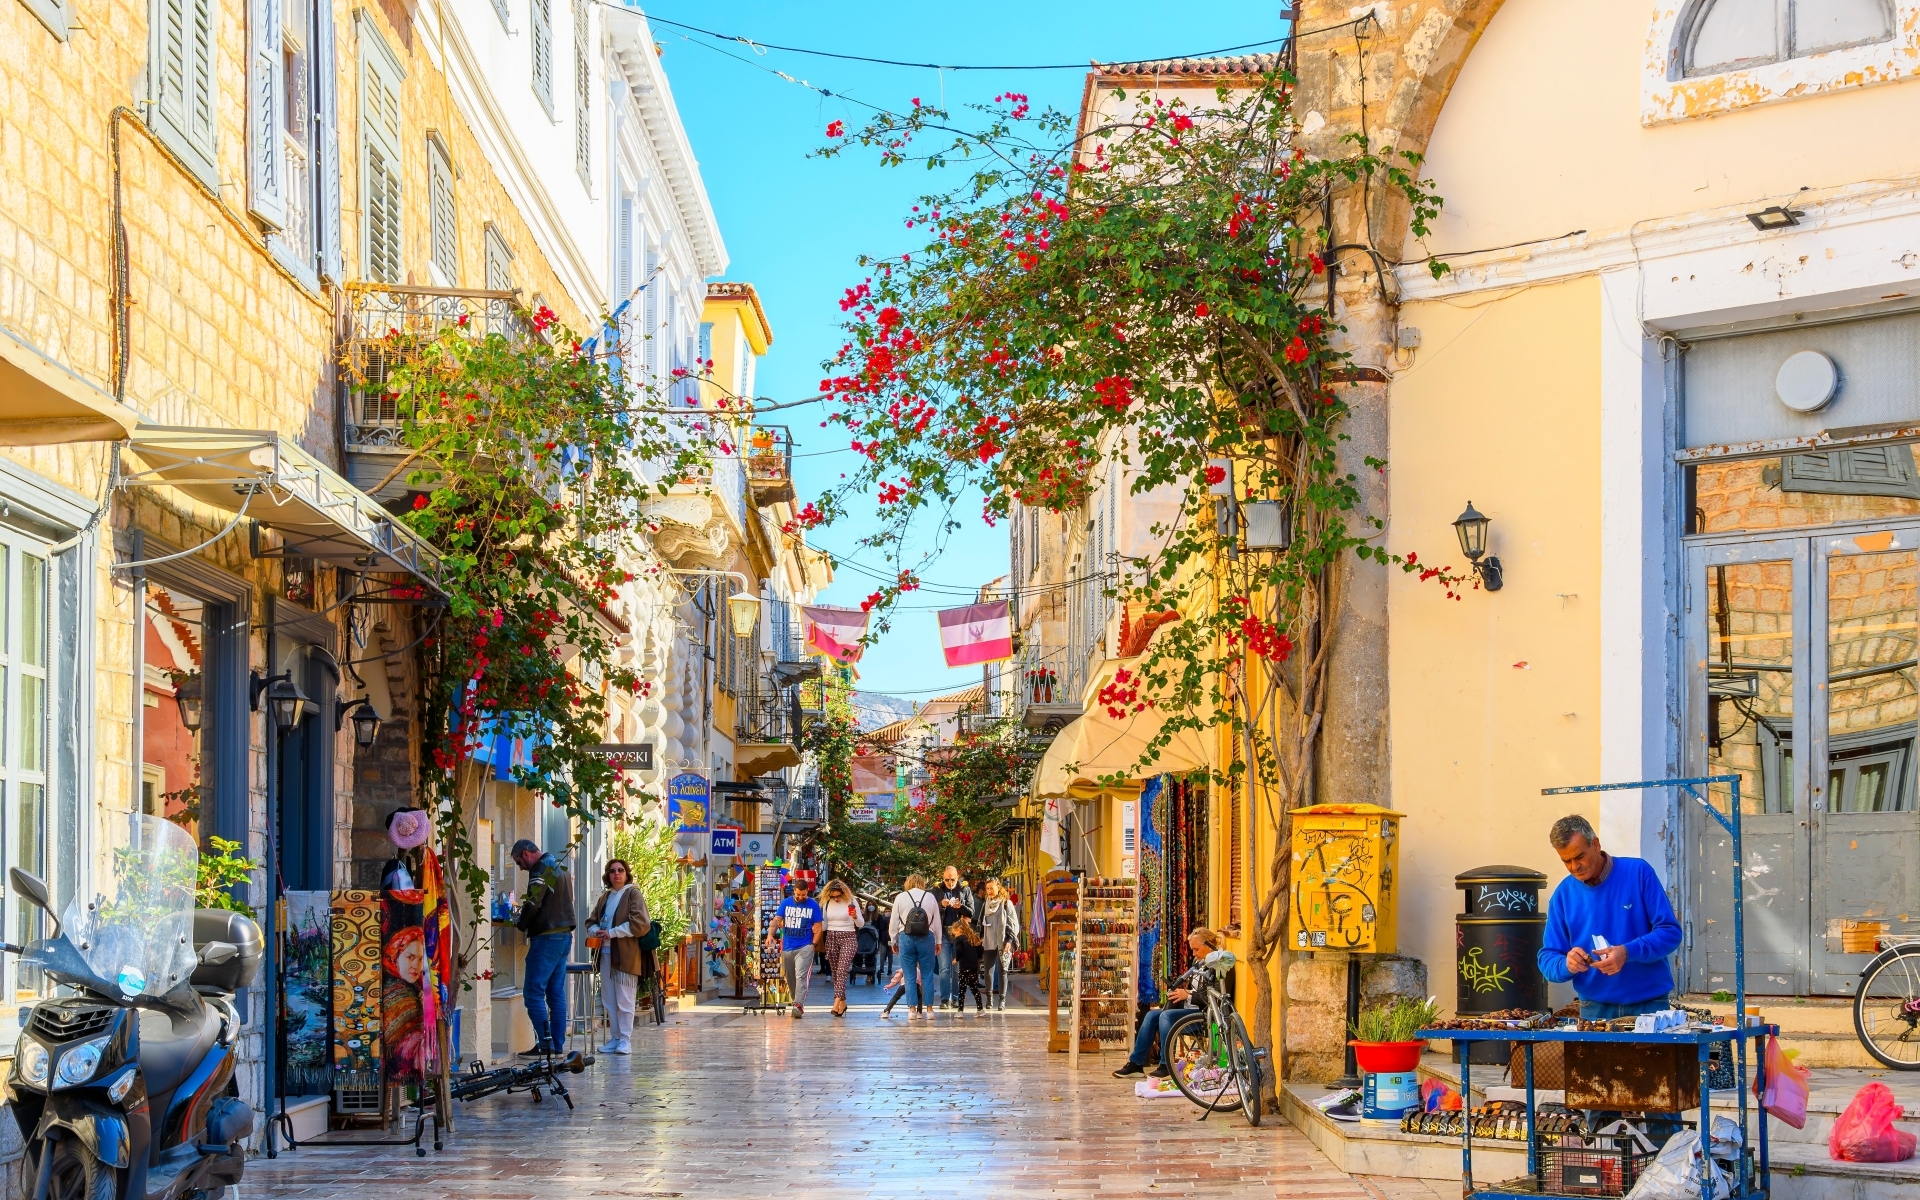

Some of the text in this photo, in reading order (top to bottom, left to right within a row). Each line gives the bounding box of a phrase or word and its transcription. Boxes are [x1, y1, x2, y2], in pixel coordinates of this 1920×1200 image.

[713, 838, 735, 848] ATM
[784, 905, 813, 919] URBAN
[784, 916, 802, 929] MEN
